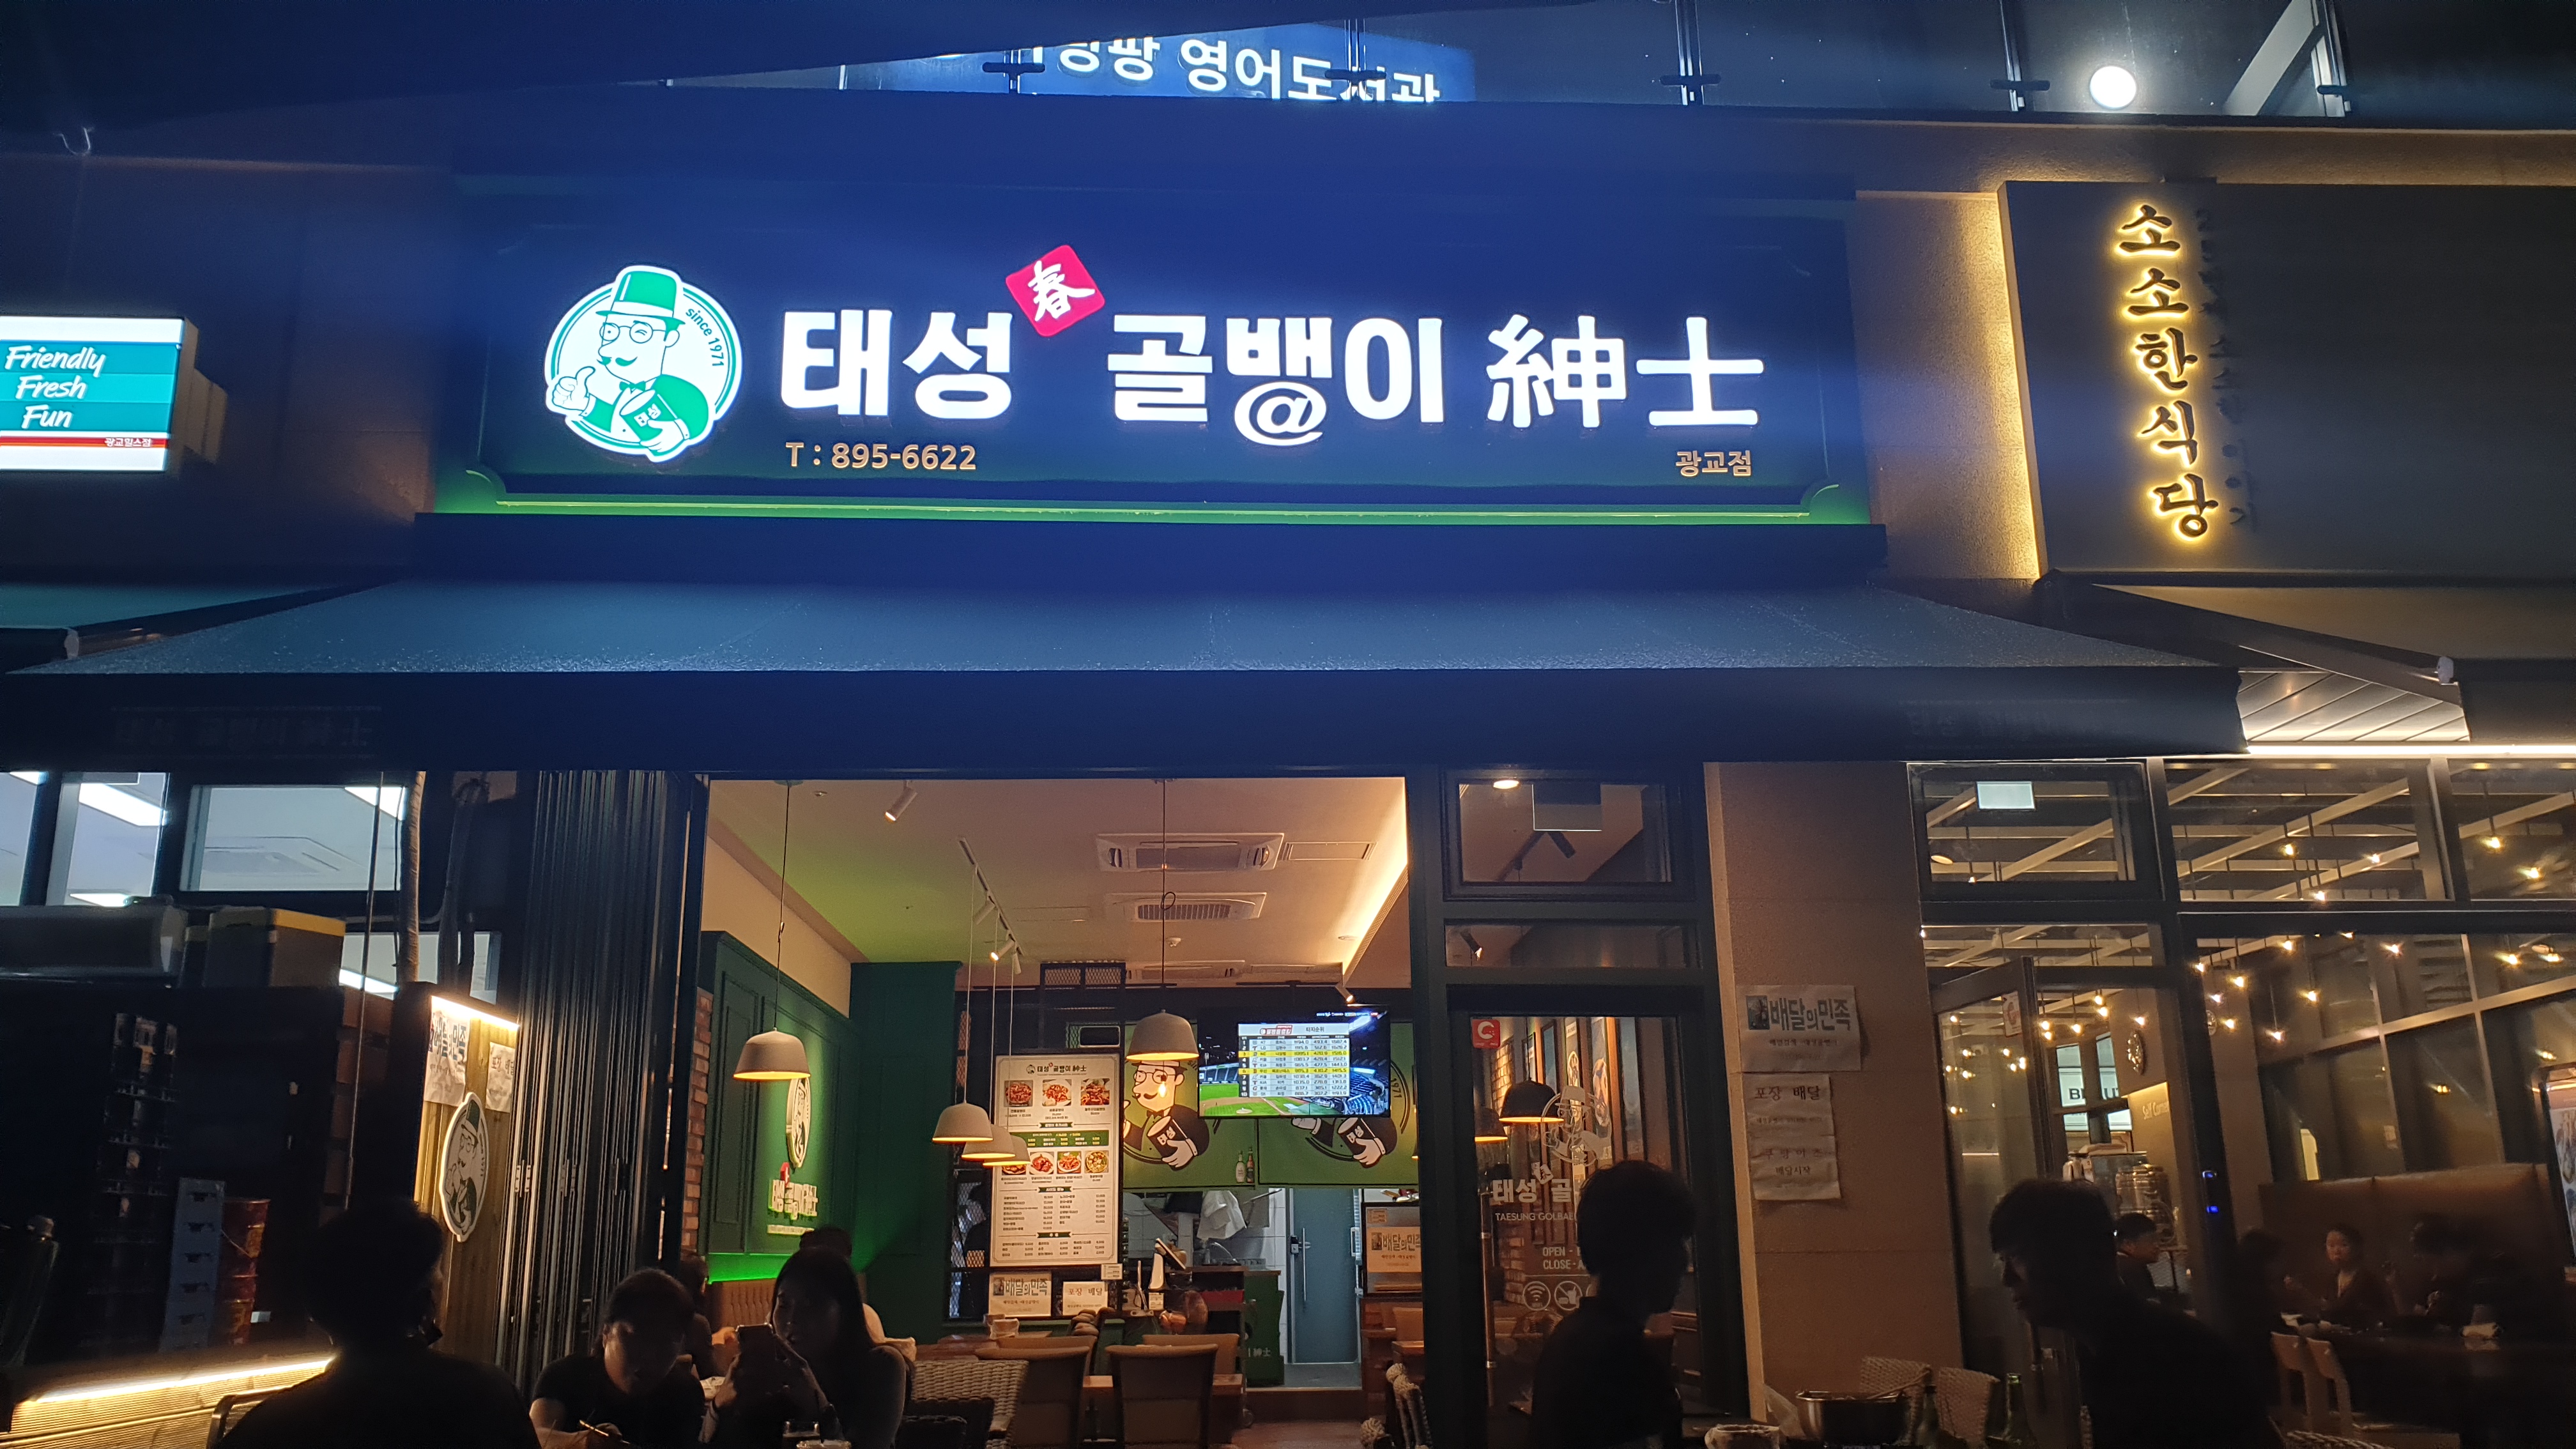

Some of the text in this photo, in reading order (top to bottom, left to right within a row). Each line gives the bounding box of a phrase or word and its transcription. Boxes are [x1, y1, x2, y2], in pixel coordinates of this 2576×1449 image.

[686, 308, 724, 366] since 1971
[4, 345, 106, 378] Friendly
[15, 374, 88, 399] Fresh
[780, 309, 1765, 446] 태성 골뱅이 紳士
[21, 404, 73, 429] Fun
[831, 441, 977, 470] 895-6622
[1675, 450, 1753, 477] 광교점
[1768, 997, 1851, 1031] 배달의민족
[1792, 1085, 1821, 1101] 배달
[1492, 1179, 1537, 1204] 태성
[1494, 1212, 1574, 1222] TAESUNG GOLBAE
[1542, 1246, 1566, 1257] OPEN
[1543, 1259, 1571, 1269] CLOSE
[1005, 1278, 1048, 1296] 배달의민족
[1068, 1287, 1103, 1296] 포장 배달
